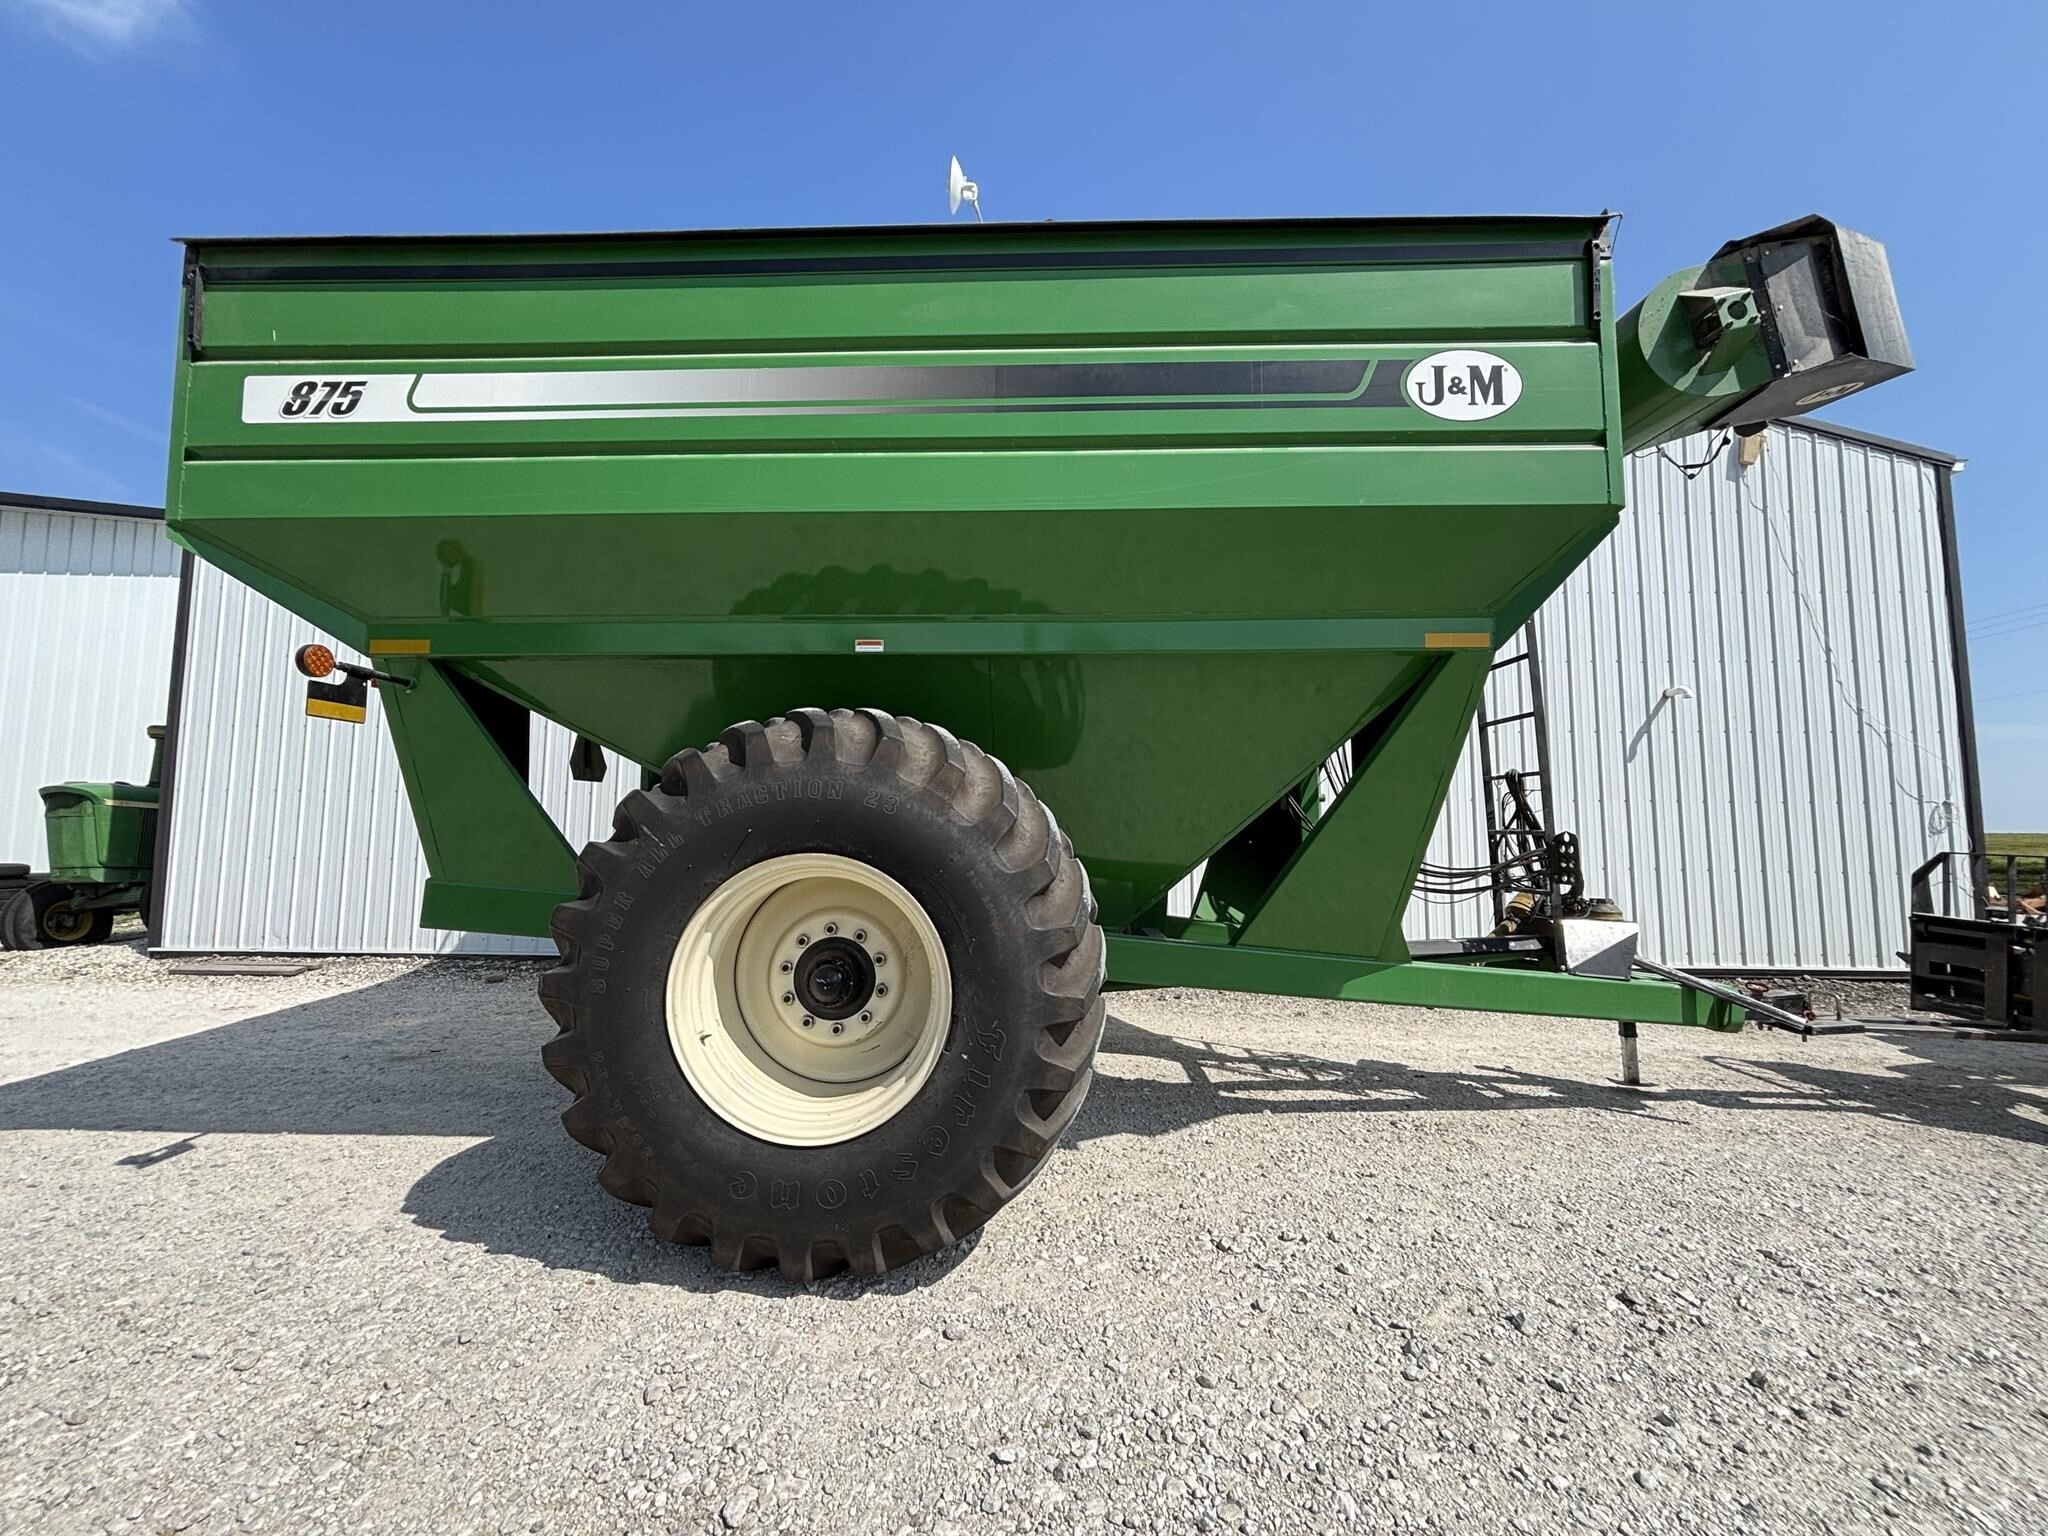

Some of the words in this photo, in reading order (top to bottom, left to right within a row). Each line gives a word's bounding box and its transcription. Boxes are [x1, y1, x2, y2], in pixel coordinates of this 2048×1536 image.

[280, 380, 369, 417] 875
[1415, 365, 1506, 406] J&M
[588, 891, 634, 994] SUPER
[636, 832, 685, 880] ALL
[695, 779, 844, 827] TRACTION
[729, 1019, 1006, 1209] Firestone
